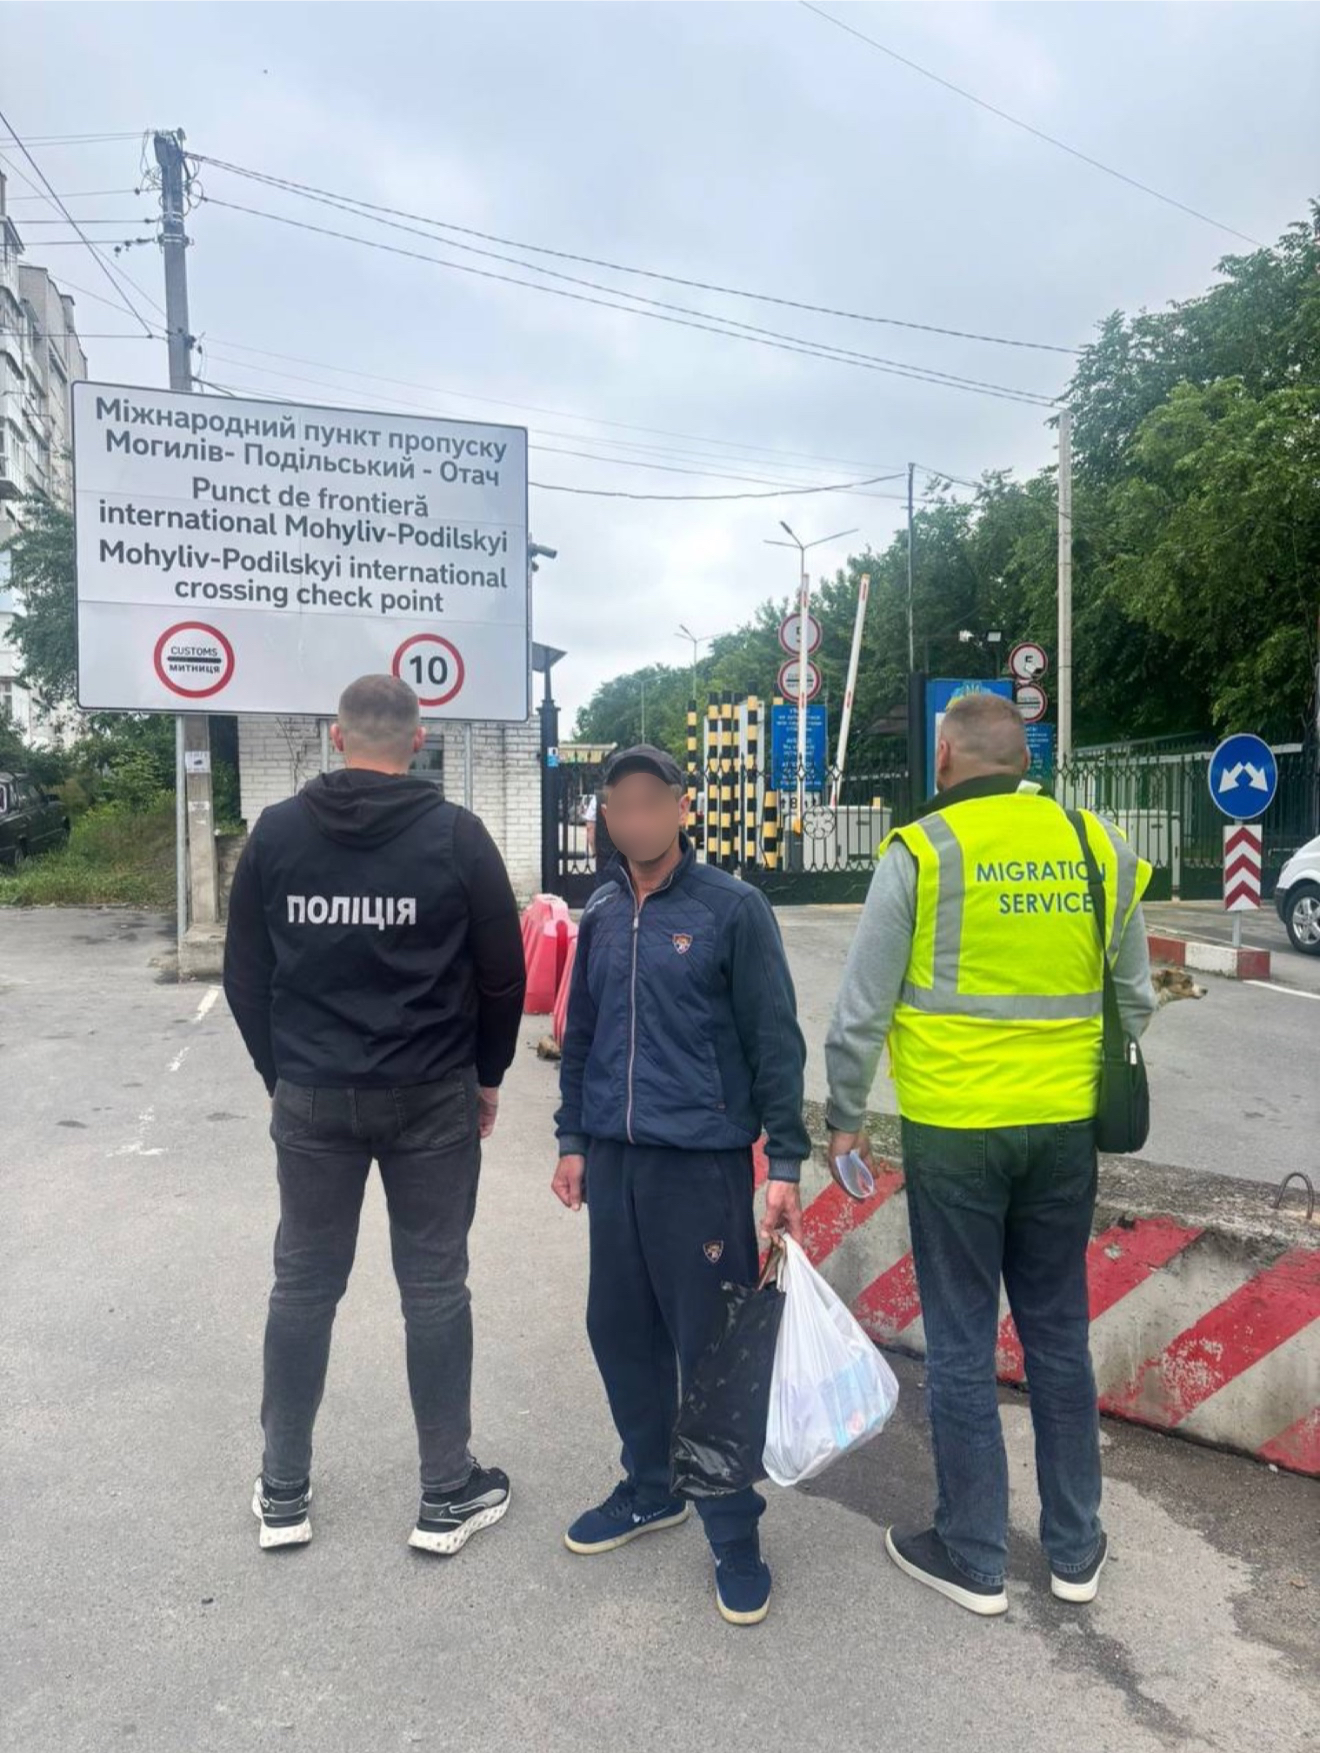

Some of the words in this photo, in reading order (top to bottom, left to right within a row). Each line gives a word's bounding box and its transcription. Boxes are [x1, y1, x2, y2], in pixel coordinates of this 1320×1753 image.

[96, 396, 295, 440] Міжнародний
[304, 424, 381, 448] пункт
[389, 432, 507, 463] пропуску
[106, 429, 235, 462] Могилів-
[245, 443, 415, 479] Подільський
[440, 461, 499, 486] Отач
[193, 477, 270, 505] Punct
[278, 484, 310, 509] de
[318, 488, 429, 518] frontieră
[100, 499, 277, 536] international
[285, 514, 508, 557] Mohyliv-Podilskyi
[100, 539, 342, 582] Mohyliv-Podilskyi
[350, 556, 508, 589] international
[175, 579, 288, 609] crossing
[297, 583, 373, 609] check
[381, 589, 444, 614] point
[169, 664, 221, 674] МИТНИЦЯ
[170, 646, 218, 657] CUSTOMS
[409, 655, 448, 685] 10
[286, 895, 417, 931] ПОЛІЦІЯ
[1000, 892, 1093, 914] SERVICE
